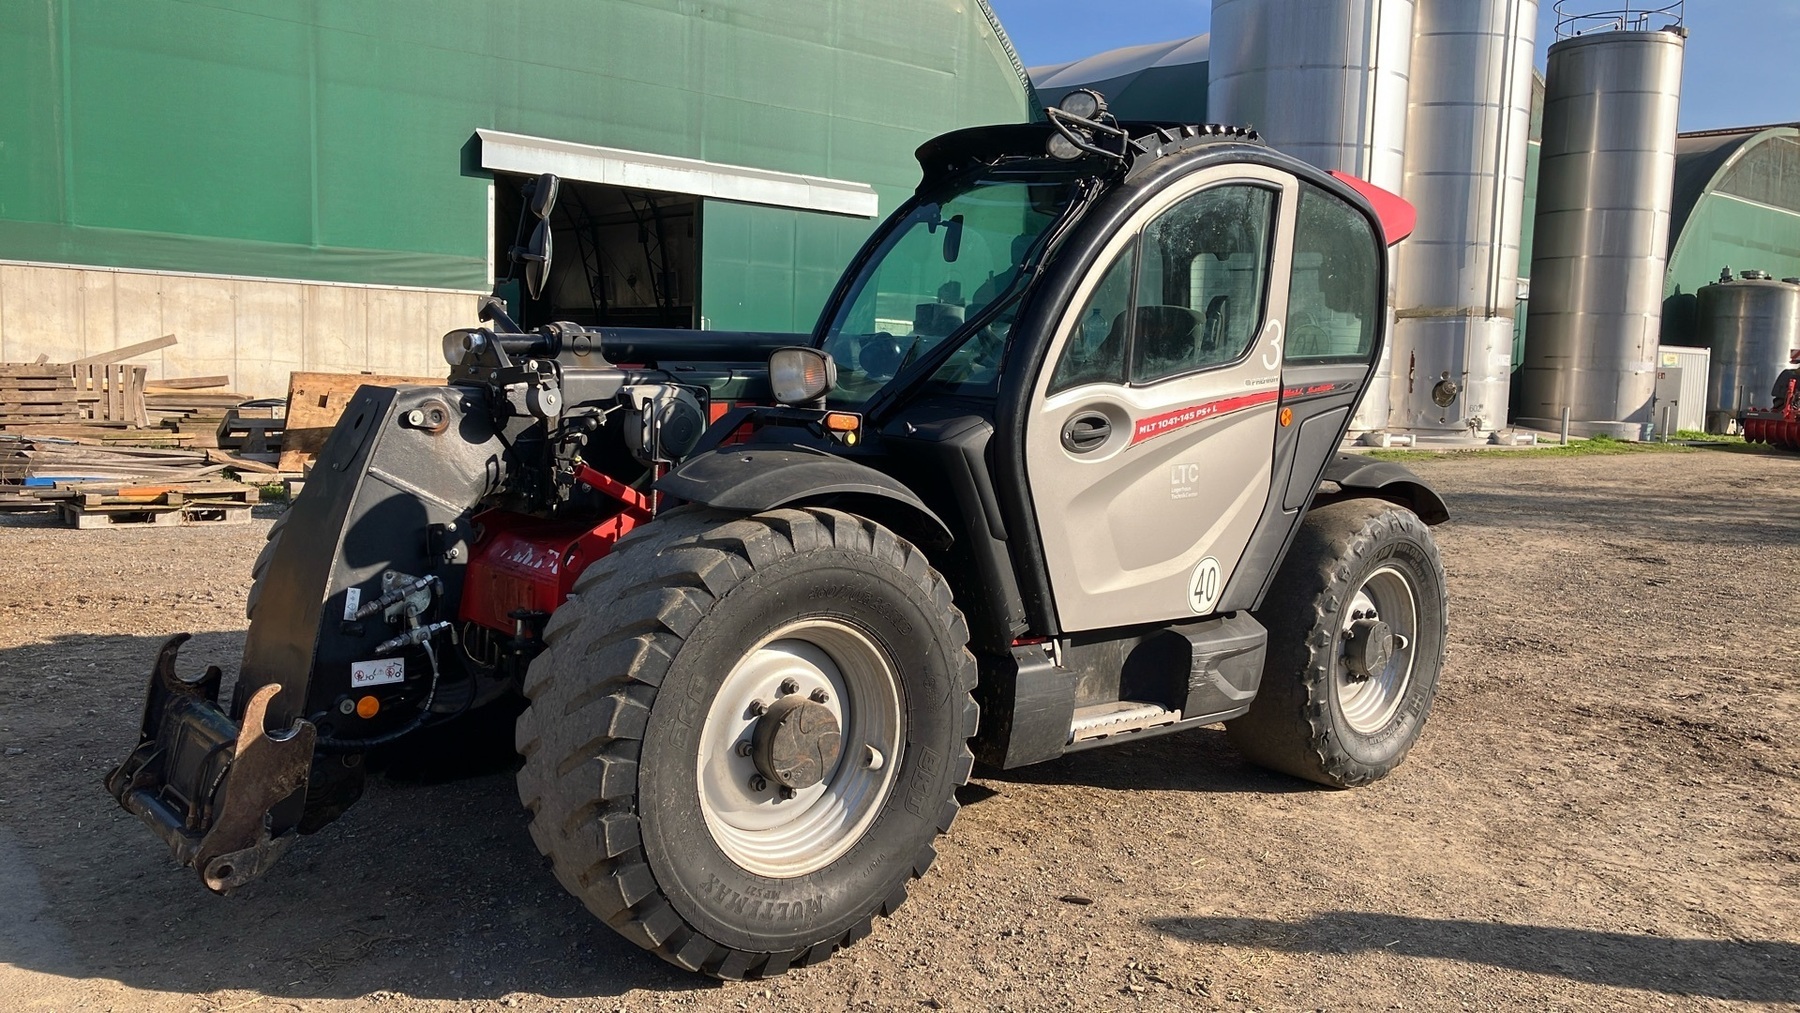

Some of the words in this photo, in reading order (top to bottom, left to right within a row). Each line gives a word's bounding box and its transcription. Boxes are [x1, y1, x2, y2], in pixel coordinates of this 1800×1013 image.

[1262, 319, 1282, 371] 3
[1139, 422, 1157, 435] MLT
[1158, 411, 1195, 429] 1041-145
[1195, 407, 1212, 418] PS+
[1212, 405, 1218, 413] L
[1171, 464, 1199, 484] LTC
[1194, 566, 1216, 604] 40
[1369, 722, 1400, 745] MICHELIN
[905, 745, 941, 820] BKT
[699, 872, 823, 921] MULTIMAX
